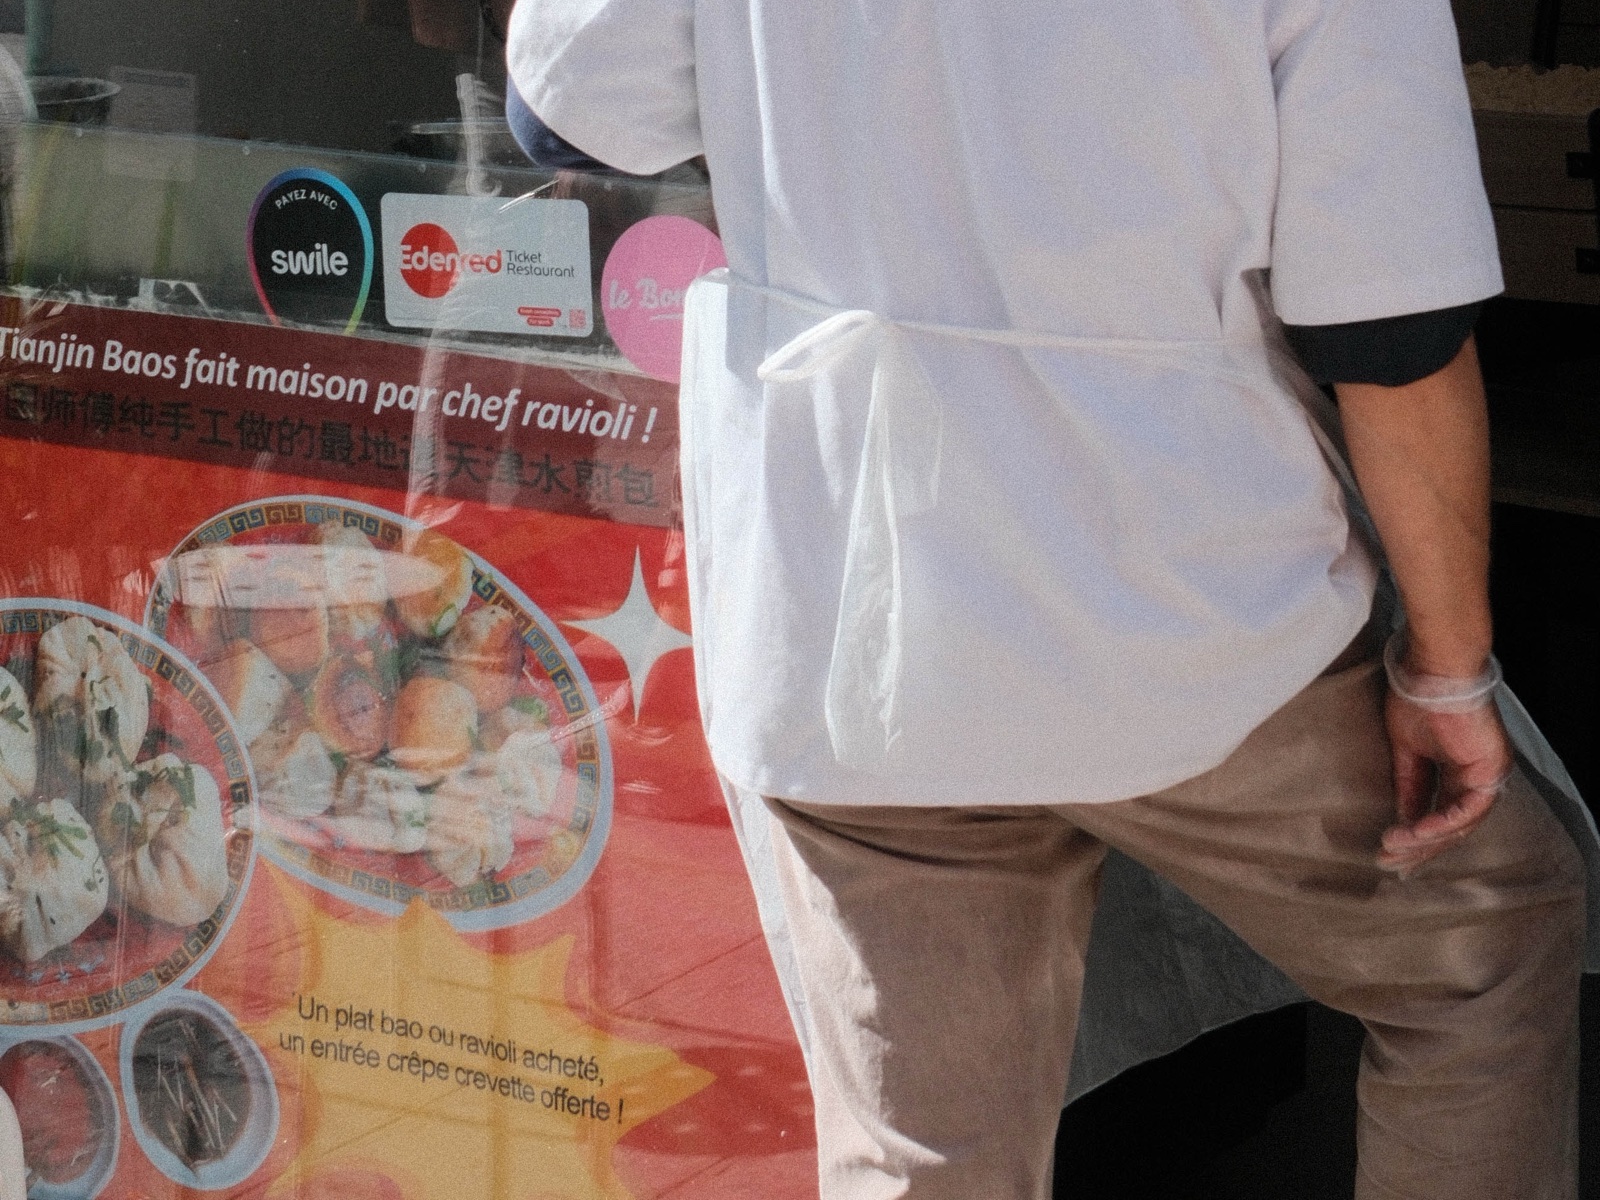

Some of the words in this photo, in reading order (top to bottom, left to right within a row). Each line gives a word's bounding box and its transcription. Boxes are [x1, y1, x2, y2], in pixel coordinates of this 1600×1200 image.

[275, 189, 307, 210] PAYEZ
[309, 190, 338, 211] AVEC
[271, 242, 349, 277] swile
[400, 244, 501, 274] Edenred
[506, 250, 542, 264] Ticket
[507, 262, 575, 278] Restaurant
[0, 326, 95, 373] Tianjin
[102, 339, 177, 379] Baos
[180, 348, 241, 389] fait
[245, 362, 368, 403] maison
[373, 380, 438, 415] par
[441, 383, 521, 432] chef
[521, 400, 638, 441] ravioli
[642, 406, 658, 444] !
[298, 995, 328, 1023] Un
[336, 1005, 373, 1032] plat
[381, 1010, 422, 1040] bao
[430, 1025, 454, 1047] ou
[460, 1034, 517, 1065] ravioli
[523, 1049, 605, 1086] acheté,
[280, 1032, 304, 1055] un
[311, 1039, 380, 1068] entrée
[387, 1051, 449, 1083] crêpe
[455, 1065, 535, 1103] crevette
[541, 1086, 611, 1122] offerte
[617, 1099, 624, 1125] !
